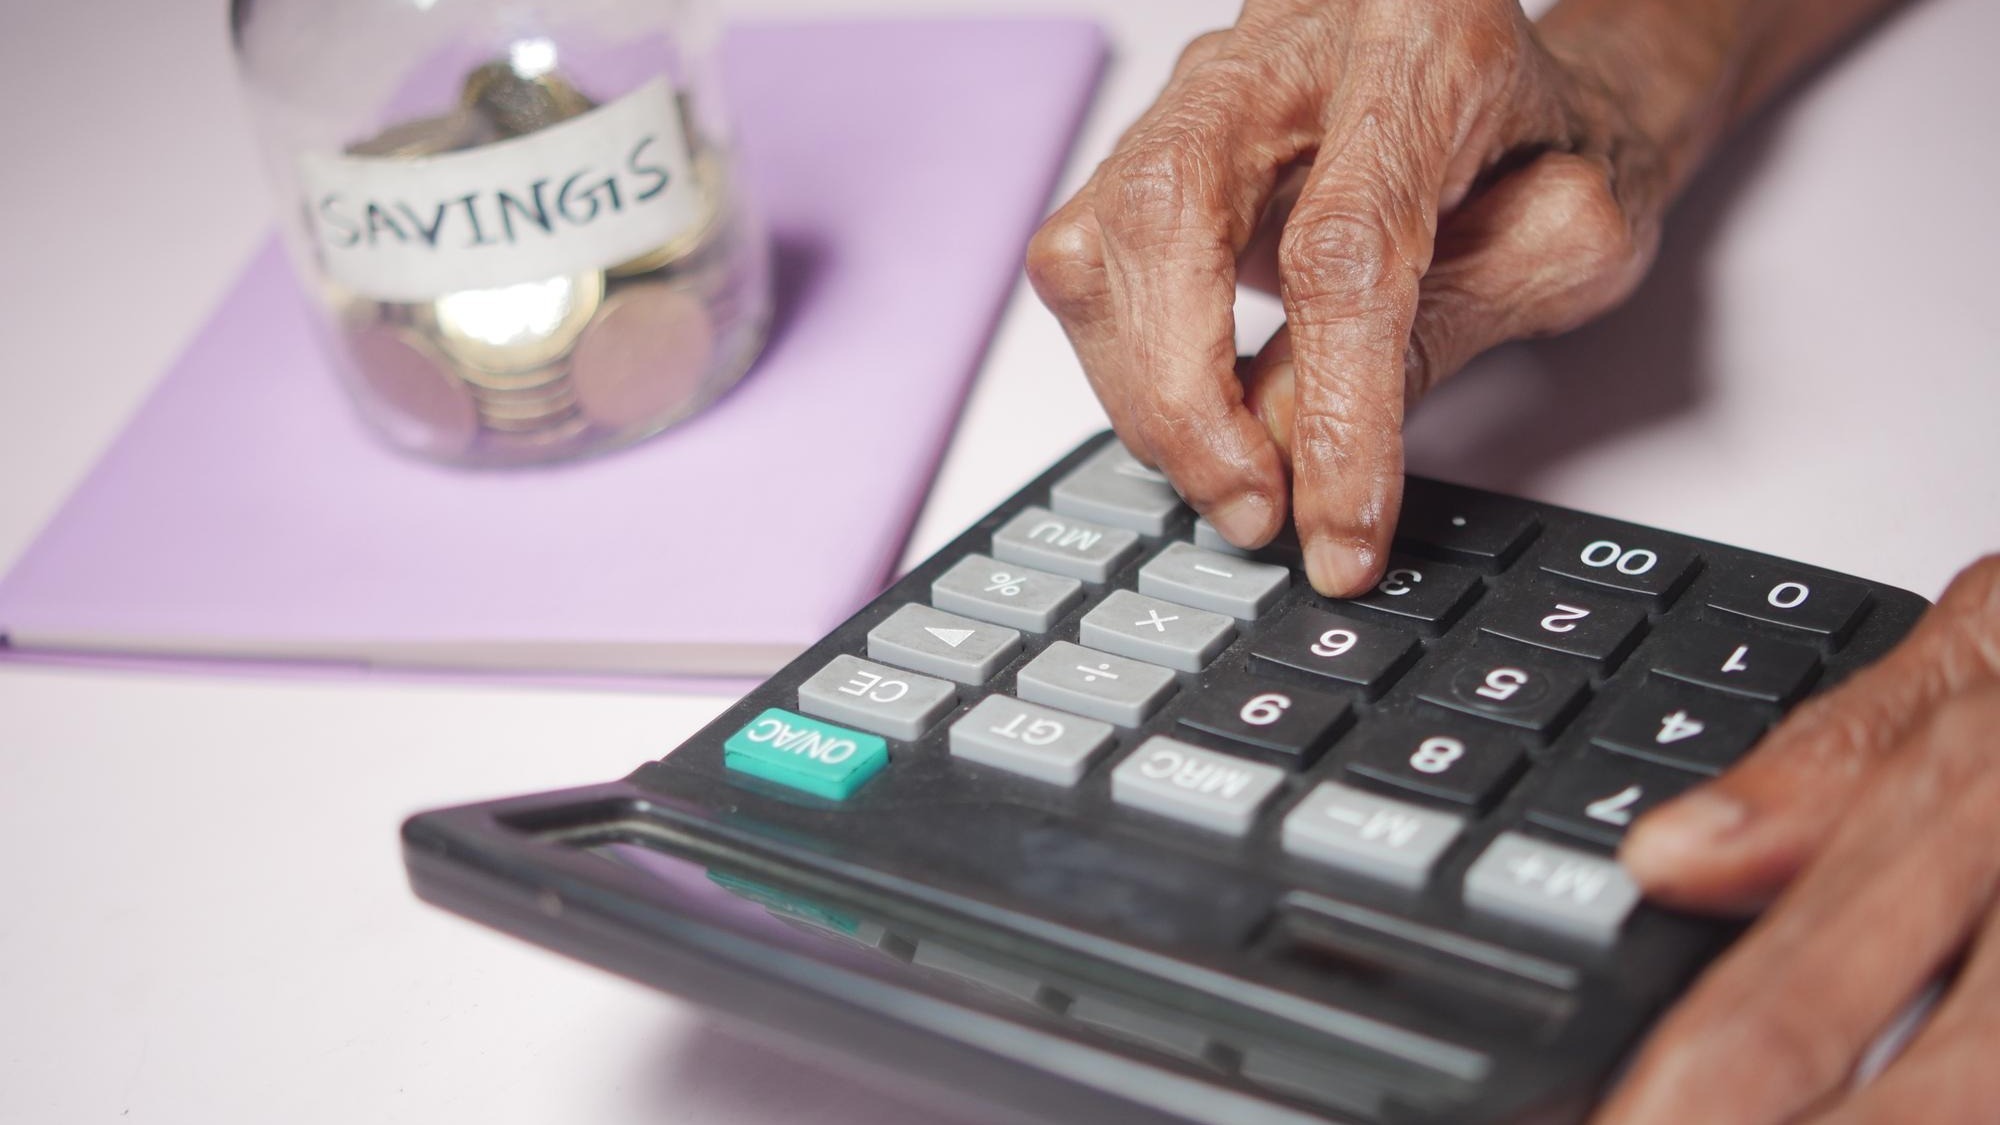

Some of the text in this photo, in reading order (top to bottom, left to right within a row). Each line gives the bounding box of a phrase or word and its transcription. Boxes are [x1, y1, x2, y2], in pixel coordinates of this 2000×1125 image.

[319, 133, 671, 249] SAVINGS
[1028, 519, 1102, 551] MU
[1579, 540, 1658, 576] 00
[990, 571, 1021, 597] %
[1379, 568, 1423, 596] 3
[1766, 581, 1810, 608] 0
[1540, 603, 1591, 633] 2
[1309, 628, 1359, 657] 6
[1719, 645, 1750, 672] 1
[838, 669, 909, 703] CE
[1475, 668, 1530, 700] 5
[1240, 693, 1291, 725] 9
[746, 718, 857, 765] ON/AC
[990, 712, 1065, 745] GT
[1654, 709, 1704, 743] 4
[1409, 737, 1465, 774] 8
[1139, 750, 1251, 798] MRC
[1584, 785, 1644, 825] 7
